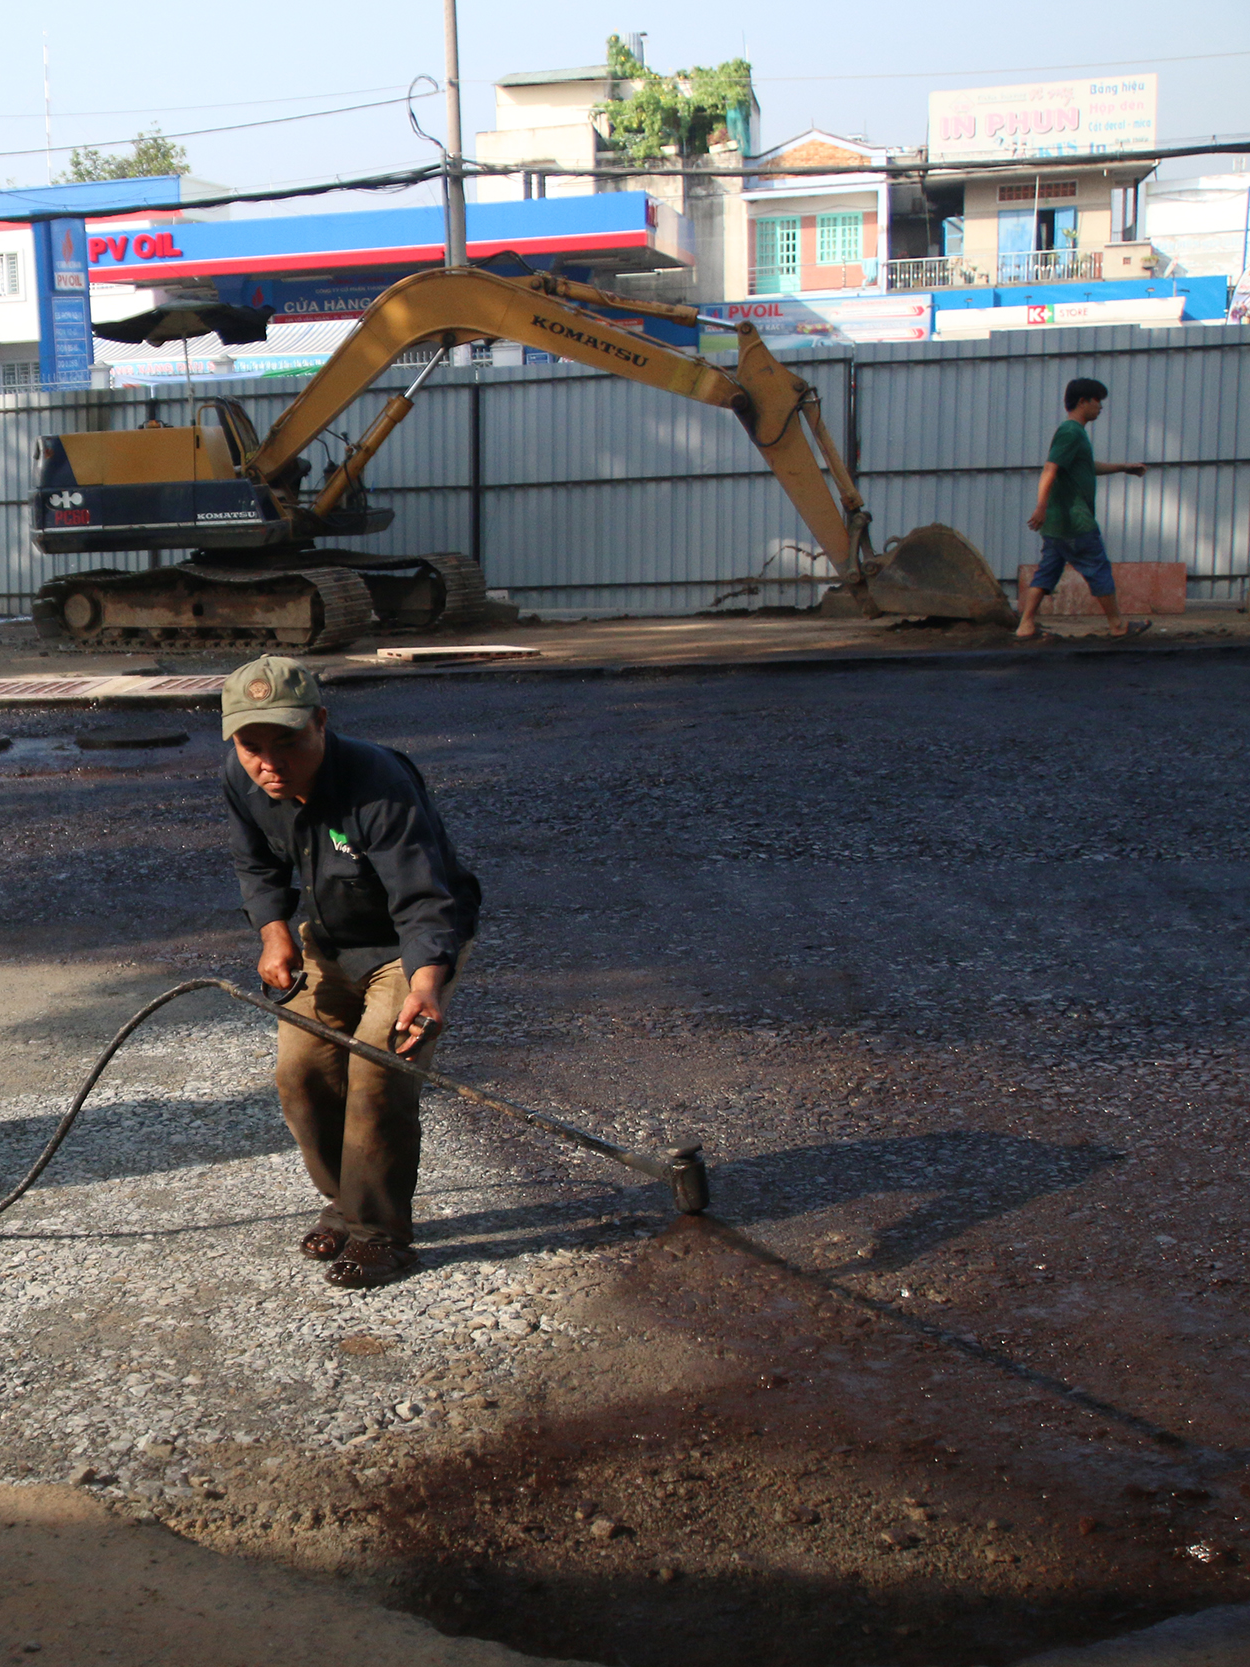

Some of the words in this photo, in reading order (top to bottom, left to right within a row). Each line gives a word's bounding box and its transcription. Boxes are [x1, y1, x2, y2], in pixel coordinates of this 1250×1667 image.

[1090, 81, 1118, 96] Bảng
[1122, 80, 1146, 95] hiệu
[940, 114, 976, 140] IN
[985, 106, 1080, 137] PHUN
[88, 235, 129, 264] PV
[132, 231, 183, 260] OIL
[283, 296, 320, 313] CỬA
[323, 296, 372, 311] HÀNG
[727, 303, 784, 319] PVOIL
[1059, 307, 1089, 318] STORE
[530, 314, 649, 368] KOMATSU
[54, 509, 91, 526] PC60
[197, 511, 257, 520] KOMATSU
